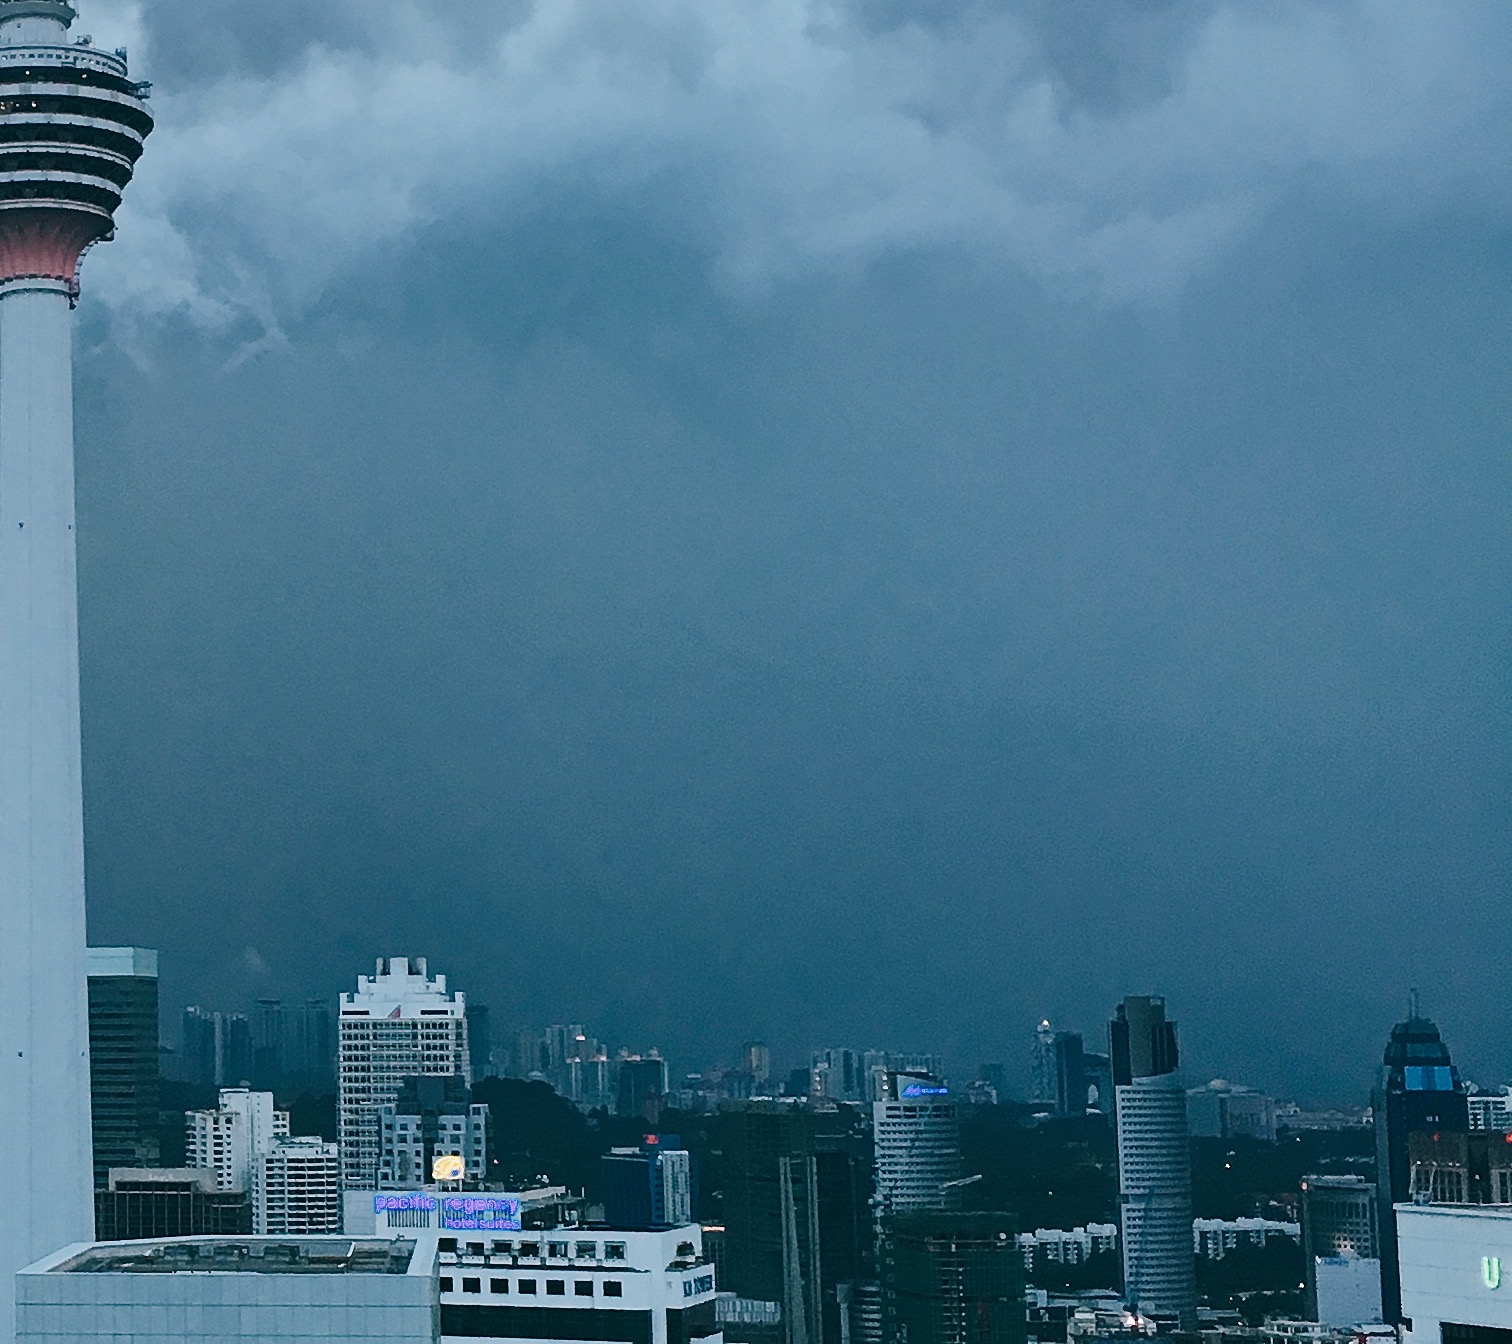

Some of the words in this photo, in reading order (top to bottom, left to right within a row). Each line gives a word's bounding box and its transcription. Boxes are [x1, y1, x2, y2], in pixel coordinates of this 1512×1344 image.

[375, 1194, 436, 1213] pacific
[443, 1197, 518, 1215] regency
[1480, 1255, 1501, 1290] U
